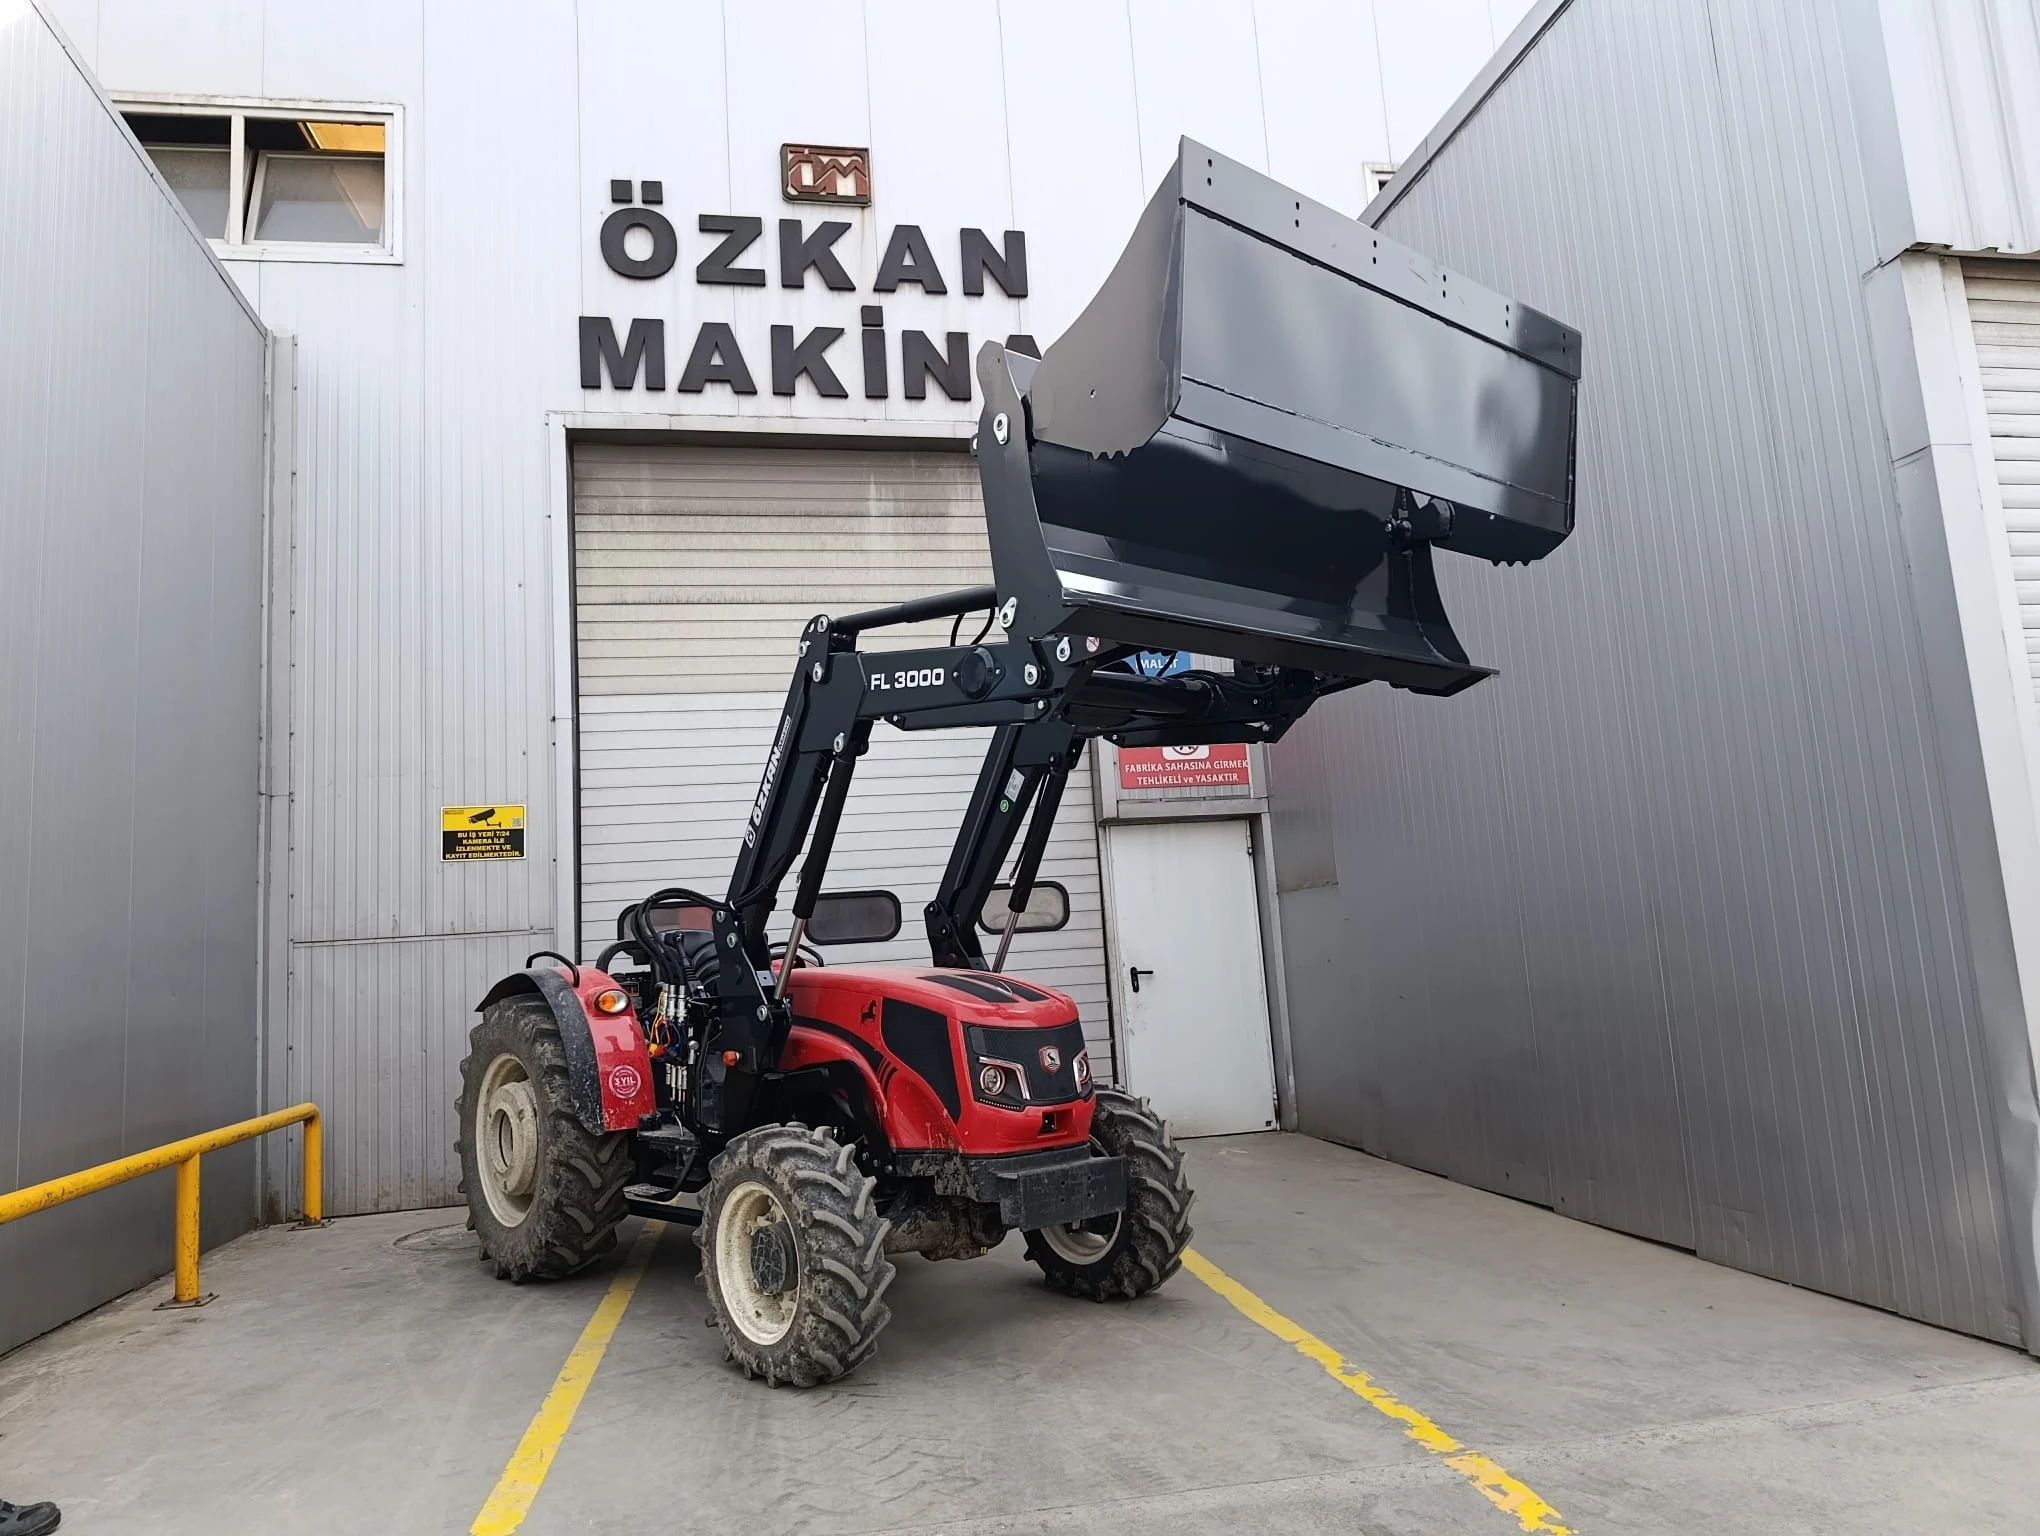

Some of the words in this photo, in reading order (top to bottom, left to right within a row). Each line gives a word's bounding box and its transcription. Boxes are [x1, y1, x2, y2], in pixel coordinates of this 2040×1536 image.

[600, 179, 1029, 298] ÖZKAN
[871, 673, 891, 691] FL
[894, 668, 945, 689] 3000
[1125, 762, 1163, 773] FABRİKA
[1165, 760, 1211, 771] SAHASINA
[1137, 774, 1181, 785] TEHLİKELİ
[1195, 773, 1238, 783] YASAKTIR
[614, 1078, 621, 1086] 3
